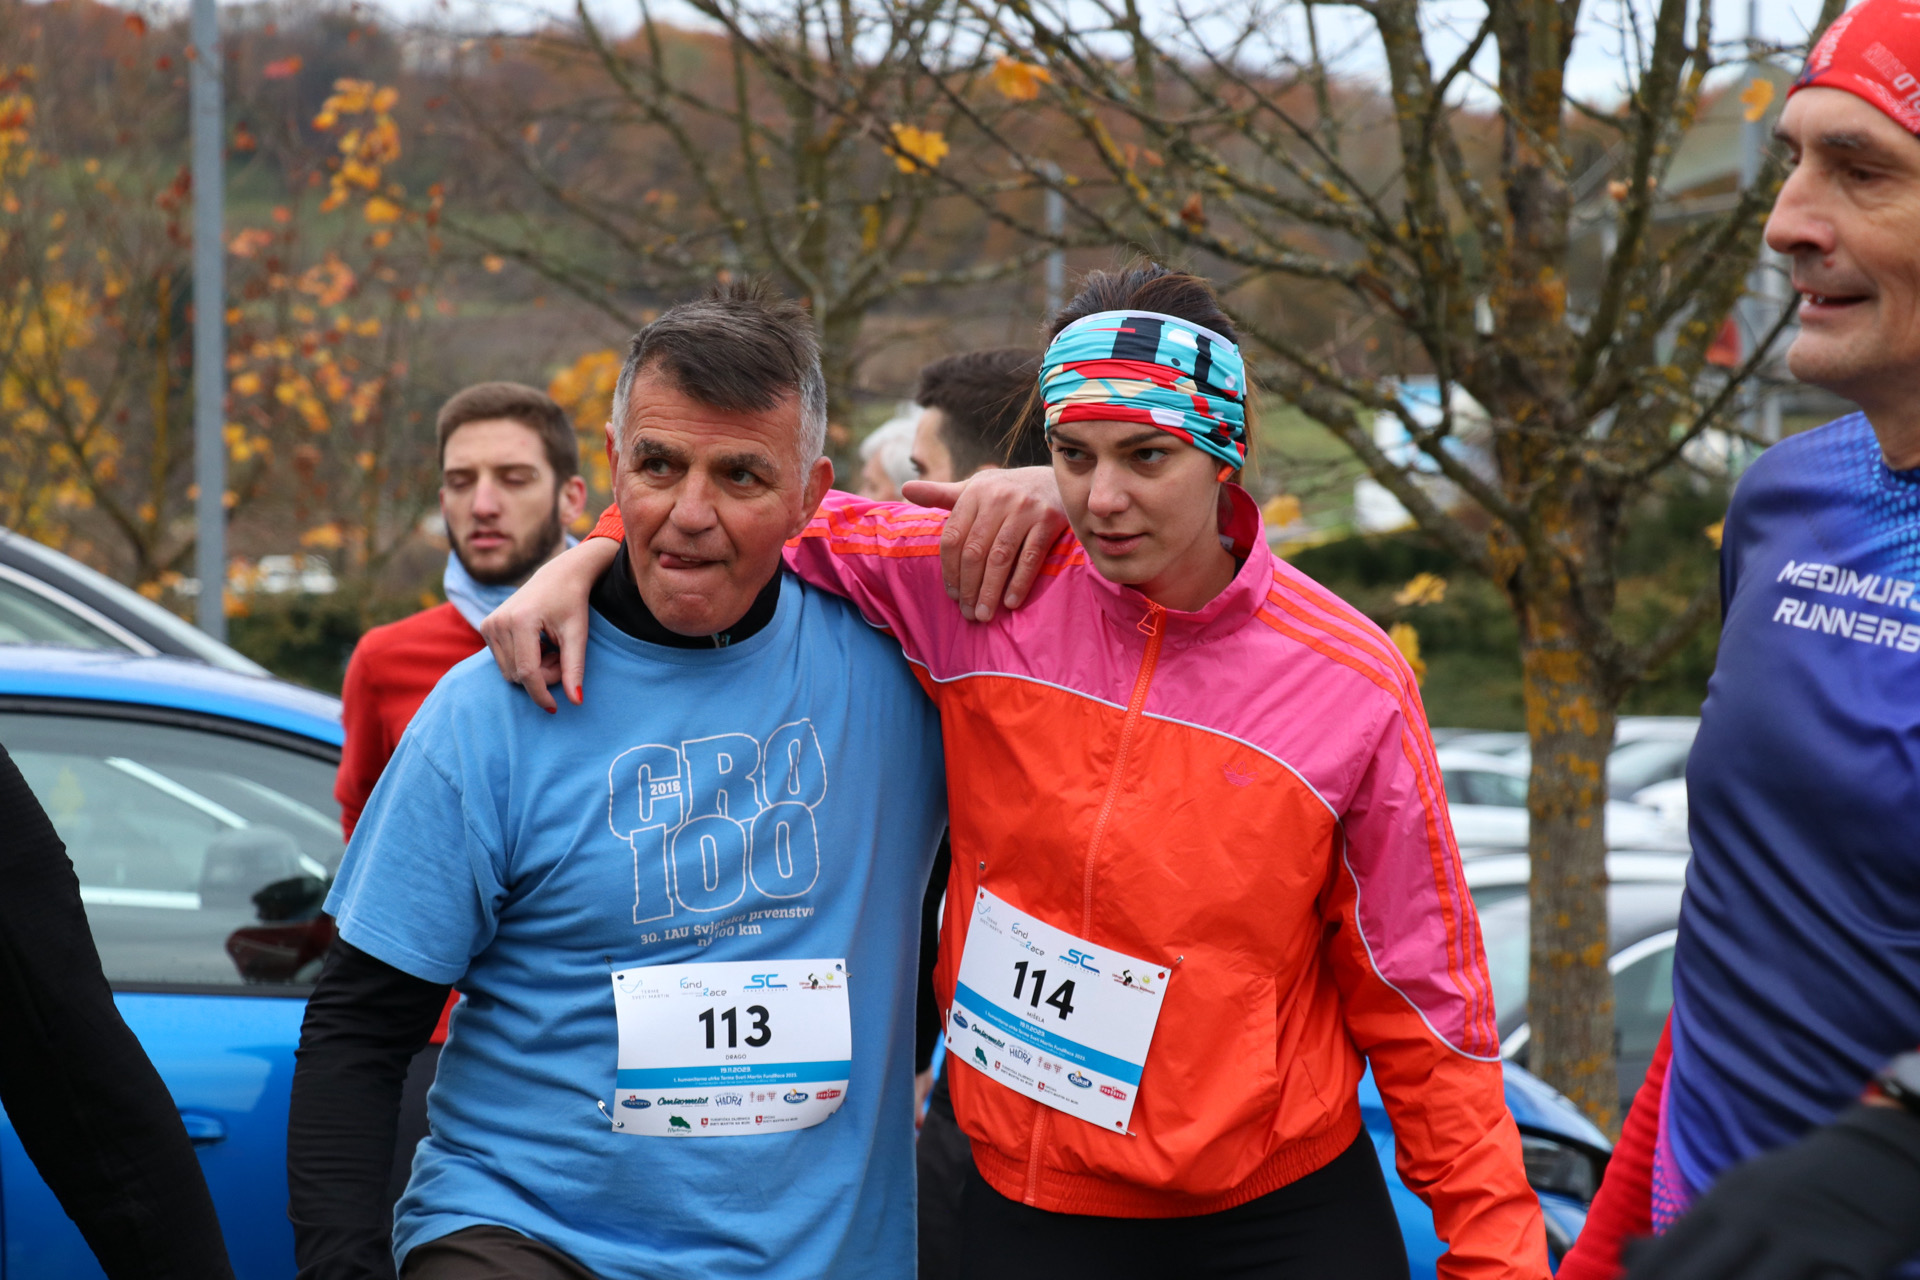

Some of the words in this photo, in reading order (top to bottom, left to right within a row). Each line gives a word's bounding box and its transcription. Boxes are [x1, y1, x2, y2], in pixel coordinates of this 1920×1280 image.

[1772, 596, 1920, 653] RUNNERS
[608, 717, 828, 841] CRO
[650, 780, 681, 795] 2018
[630, 801, 820, 925] 100
[640, 933, 661, 945] 30.
[664, 927, 689, 940] IAU
[748, 906, 815, 922] prvenstvo
[738, 923, 762, 937] km
[1058, 948, 1100, 974] SC
[679, 976, 702, 989] Fund
[743, 973, 788, 989] SC
[1013, 960, 1076, 1021] 114
[698, 1004, 772, 1049] 113
[725, 1053, 747, 1061] DRAGO
[1070, 1075, 1090, 1087] Dukat
[786, 1093, 807, 1102] Dukat
